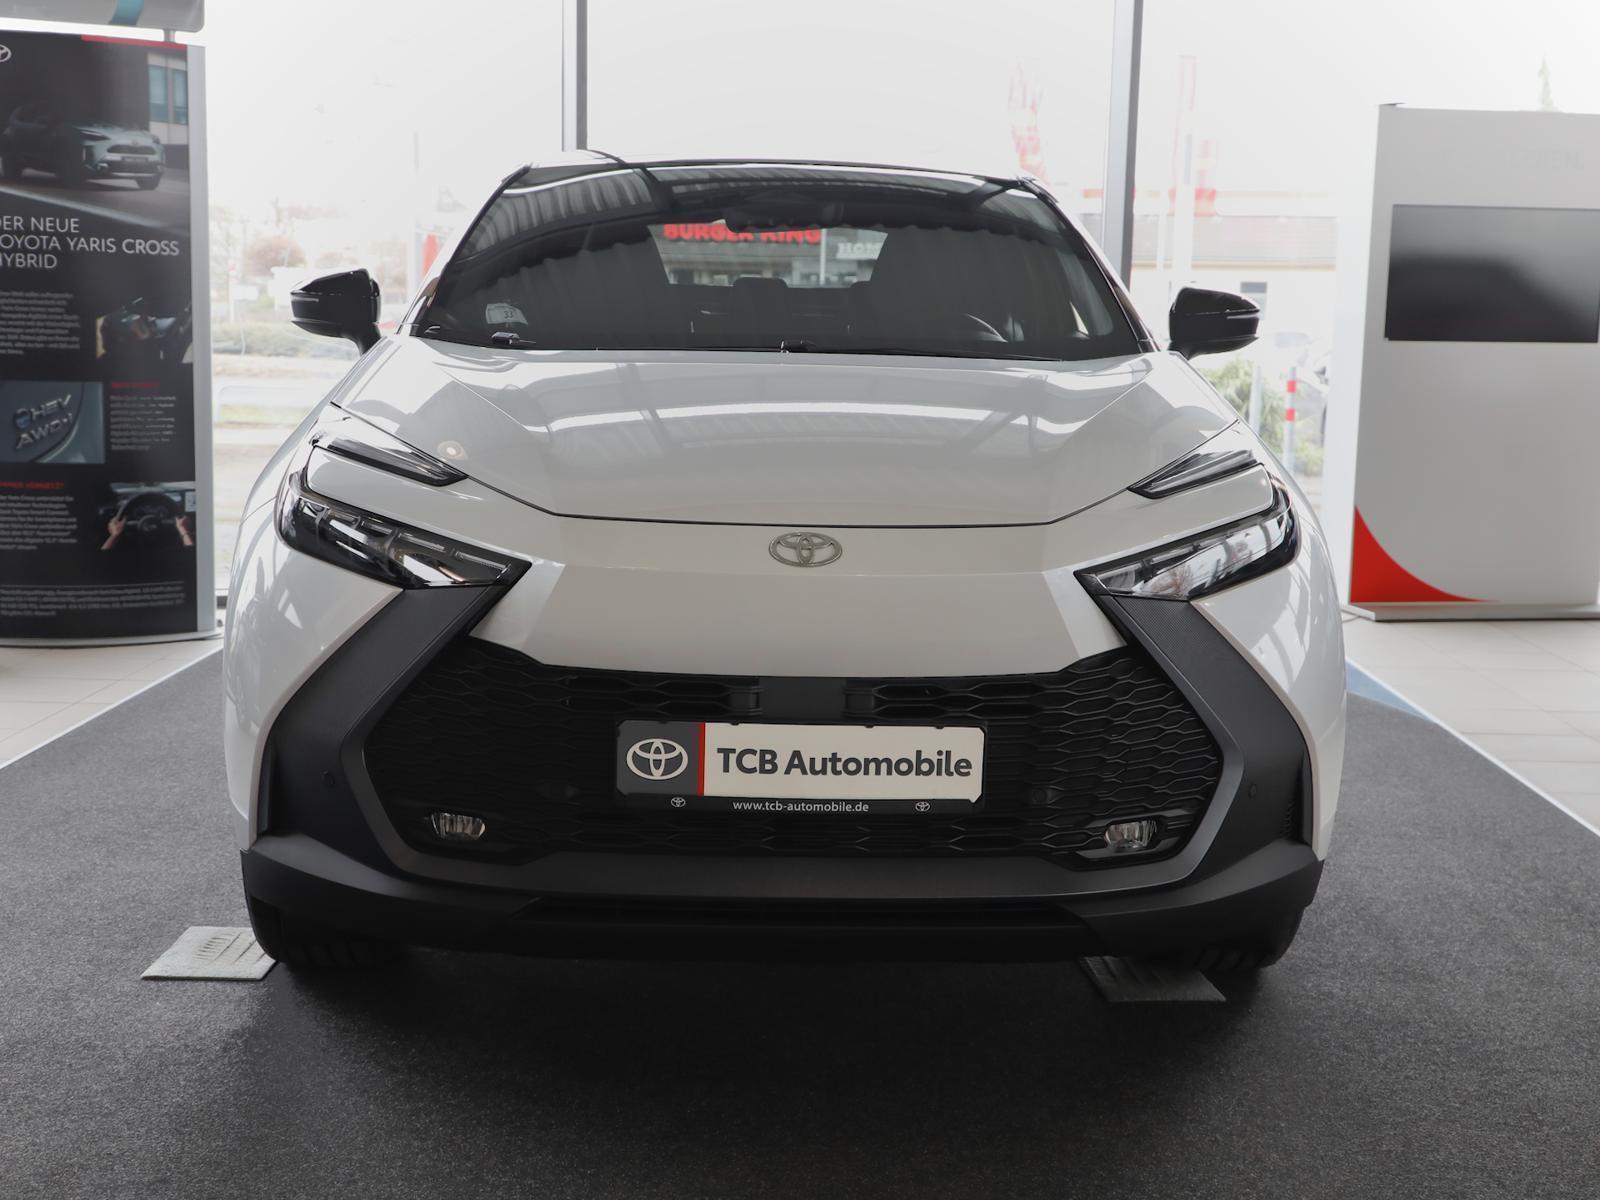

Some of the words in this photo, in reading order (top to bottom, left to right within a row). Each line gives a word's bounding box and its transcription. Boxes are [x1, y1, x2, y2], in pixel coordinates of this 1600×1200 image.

[0, 215, 24, 230] ER
[31, 216, 80, 233] NEUE
[0, 234, 61, 250] OYOTA
[67, 237, 116, 253] YARIS
[122, 238, 180, 256] CROSS
[0, 252, 57, 268] YBRID
[717, 747, 778, 774] TCB
[784, 749, 972, 777] Automobile
[733, 800, 869, 813] www.tcb-automobile.de
